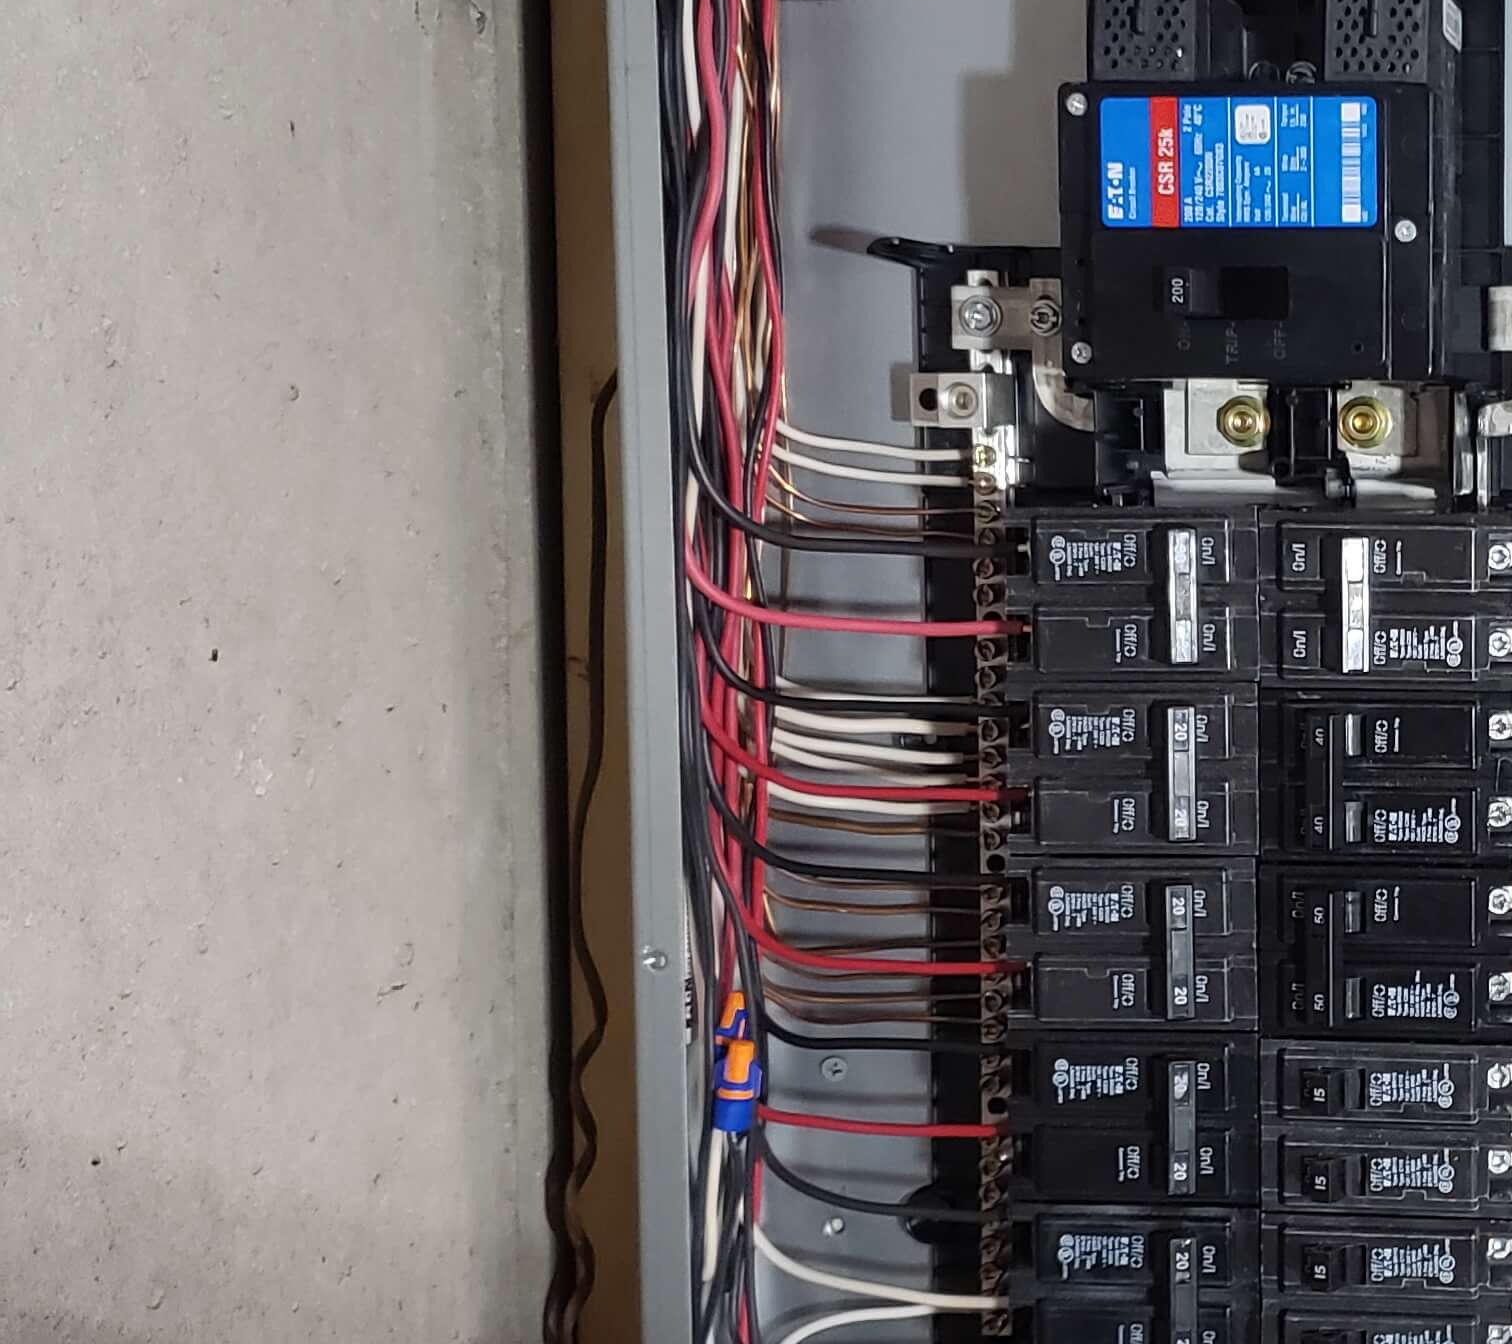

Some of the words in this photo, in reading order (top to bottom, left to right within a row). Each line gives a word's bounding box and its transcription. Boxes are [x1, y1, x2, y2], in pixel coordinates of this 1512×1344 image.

[1158, 128, 1174, 157] 25k
[1158, 162, 1175, 195] CSR
[1108, 162, 1123, 219] EATON
[1172, 277, 1183, 303] 200
[1175, 722, 1188, 741] 20
[1315, 729, 1325, 745] 40
[1175, 808, 1187, 827] 20
[1314, 817, 1325, 833] 40
[1173, 897, 1185, 916] 20
[1314, 907, 1325, 924] 50
[1174, 986, 1187, 1005] 20
[1314, 994, 1325, 1011] 50
[1313, 1087, 1326, 1101] 15
[1174, 1162, 1186, 1181] 20
[1314, 1176, 1326, 1190] 15
[1314, 1265, 1327, 1279] 15
